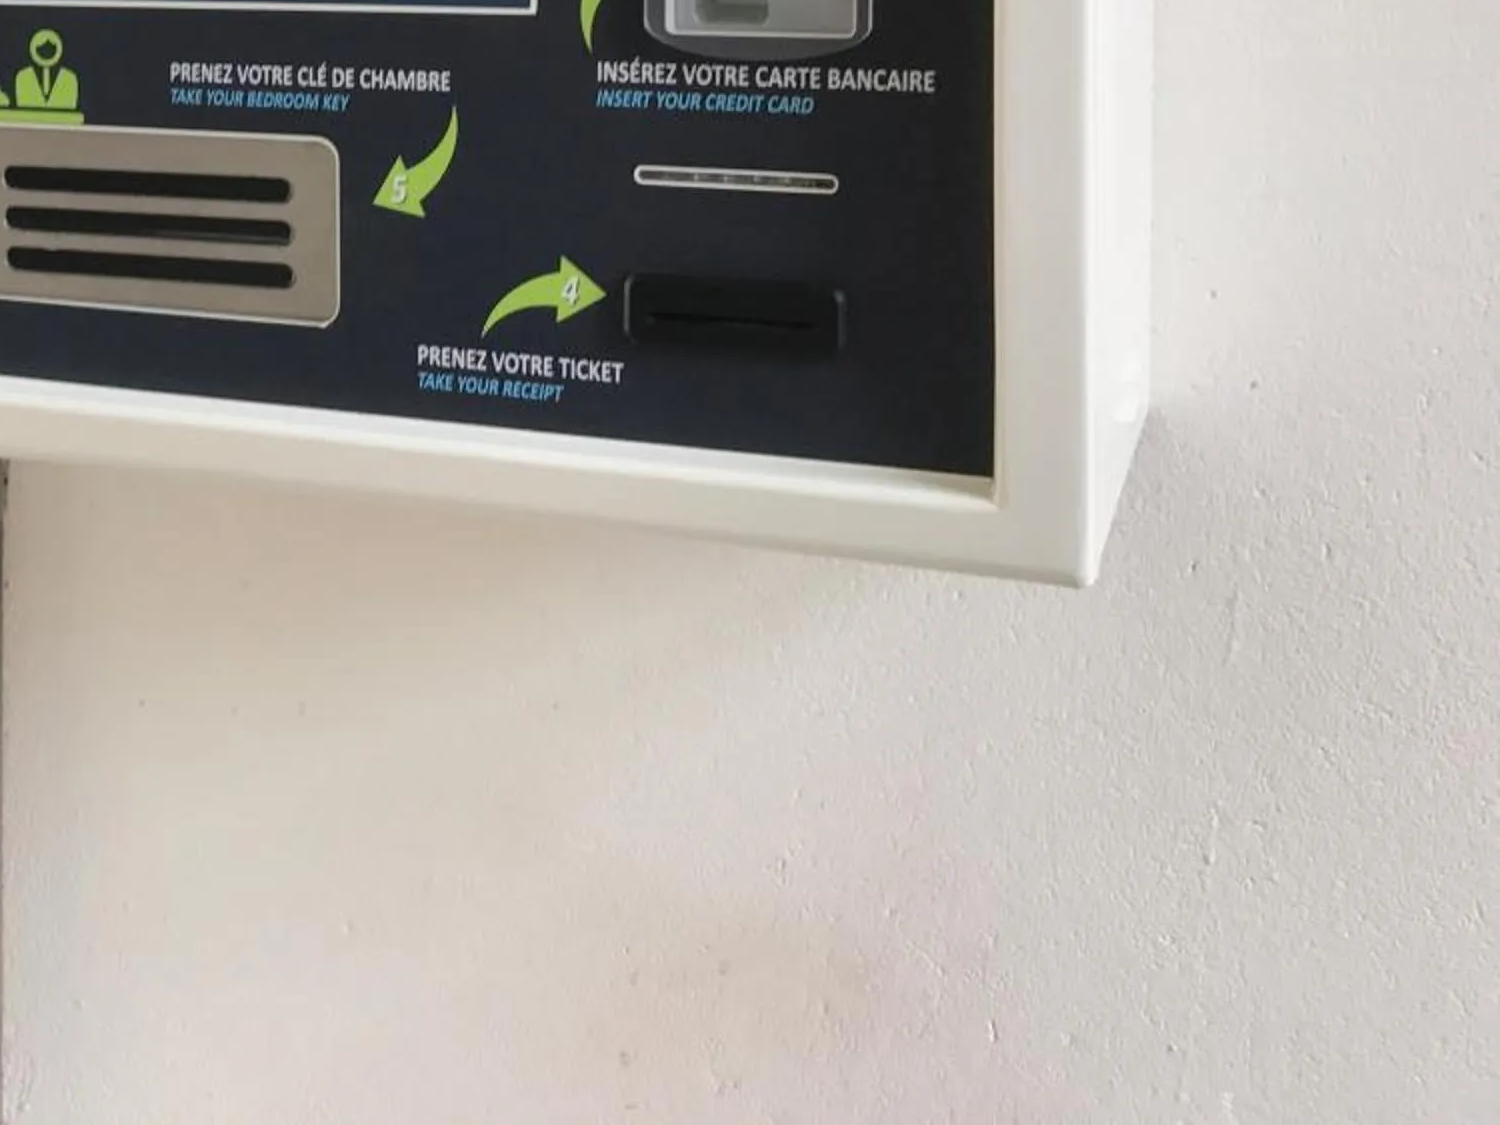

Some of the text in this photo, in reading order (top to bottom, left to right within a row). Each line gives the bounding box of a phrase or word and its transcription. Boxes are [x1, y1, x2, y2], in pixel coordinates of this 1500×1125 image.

[169, 61, 452, 92] PRENEZ VOTRE CLÉ DE CHAMBRE
[597, 56, 936, 93] INSÉREZ VOTRE CARTE BANCAIRE
[170, 87, 351, 112] TAKE YOUR BEDROOM KEY
[596, 89, 815, 115] INSERT YOUR CREDIT CARD
[391, 174, 408, 205] 5
[561, 274, 581, 306] 4
[417, 343, 625, 385] PRENEZ VOTRE TICKET
[418, 371, 565, 403] TAKE YOUR RECEIPT
